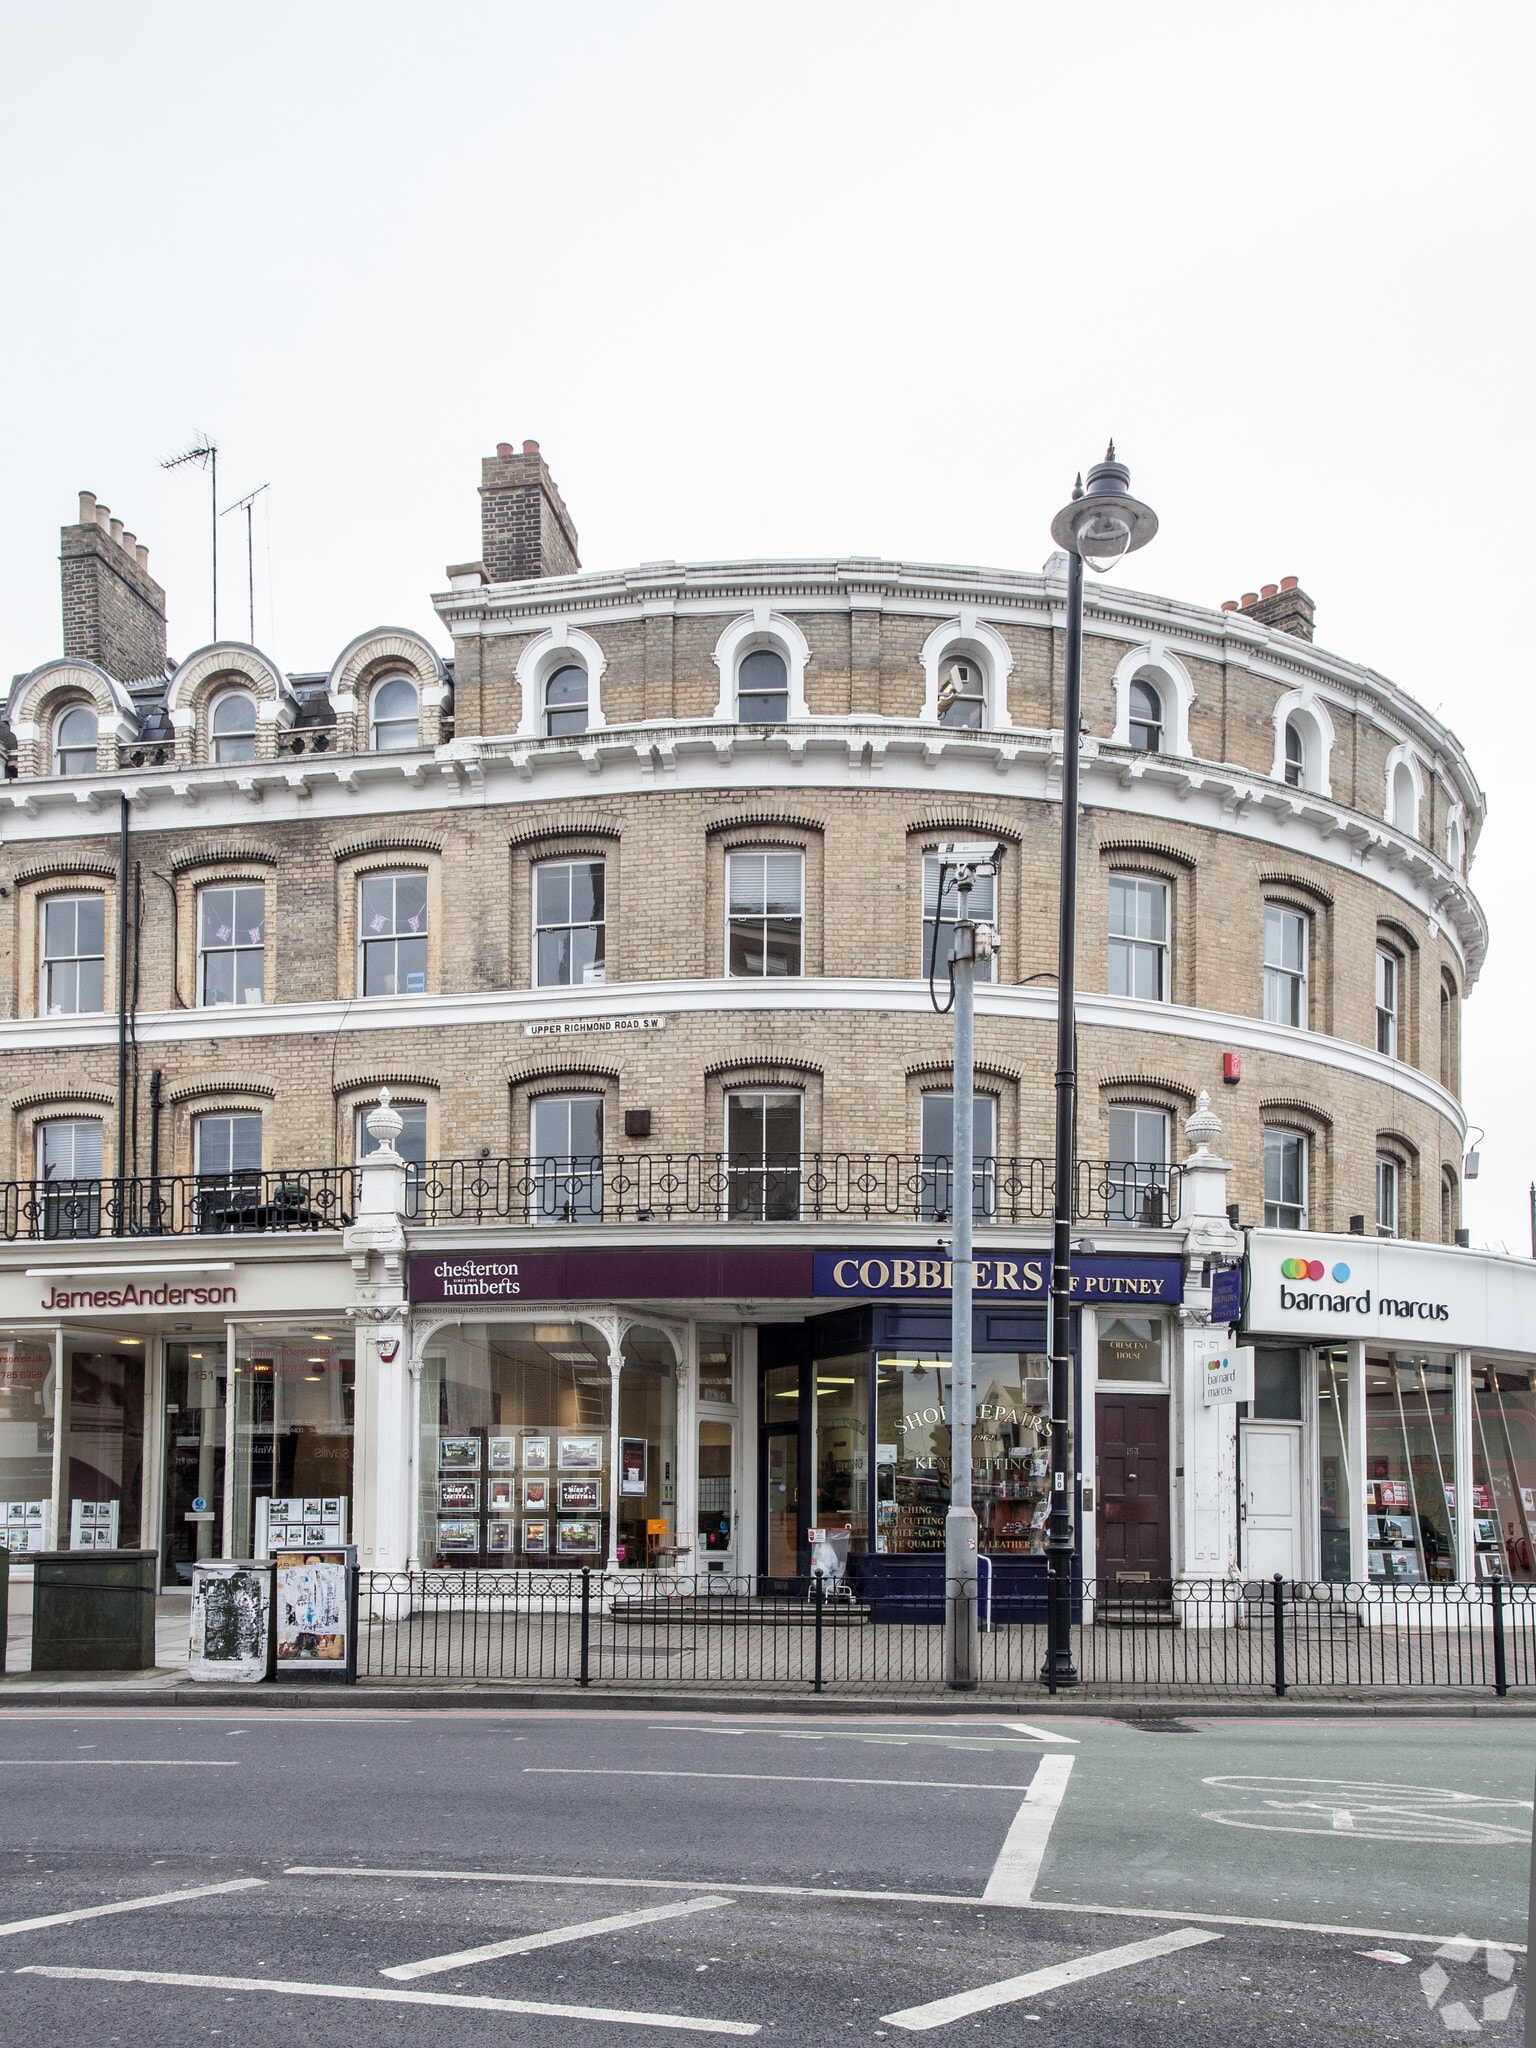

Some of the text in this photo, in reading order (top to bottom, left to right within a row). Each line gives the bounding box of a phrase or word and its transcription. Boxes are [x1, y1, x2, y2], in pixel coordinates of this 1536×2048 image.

[531, 1025, 561, 1034] UPPER
[564, 1022, 611, 1033] RICHMOND
[434, 1260, 519, 1277] chesterton
[443, 1277, 521, 1296] humberts
[1085, 1276, 1164, 1295] PUTNEY
[41, 1282, 237, 1310] JamesAnderson
[1280, 1284, 1449, 1321] barnard marcus
[1110, 1341, 1149, 1350] CRESCENT
[1116, 1352, 1142, 1360] HOUSE
[193, 1370, 214, 1381] 151
[1207, 1369, 1236, 1386] barnard
[1207, 1386, 1233, 1398] marcus
[975, 1403, 1053, 1438] EPAIRS
[1126, 1447, 1139, 1456] 153
[914, 1457, 1035, 1470] KEY UTTING
[902, 1517, 944, 1526] CUTTING
[882, 1529, 946, 1538] WHILE-U-WAI
[988, 1541, 1031, 1549] LEATHER
